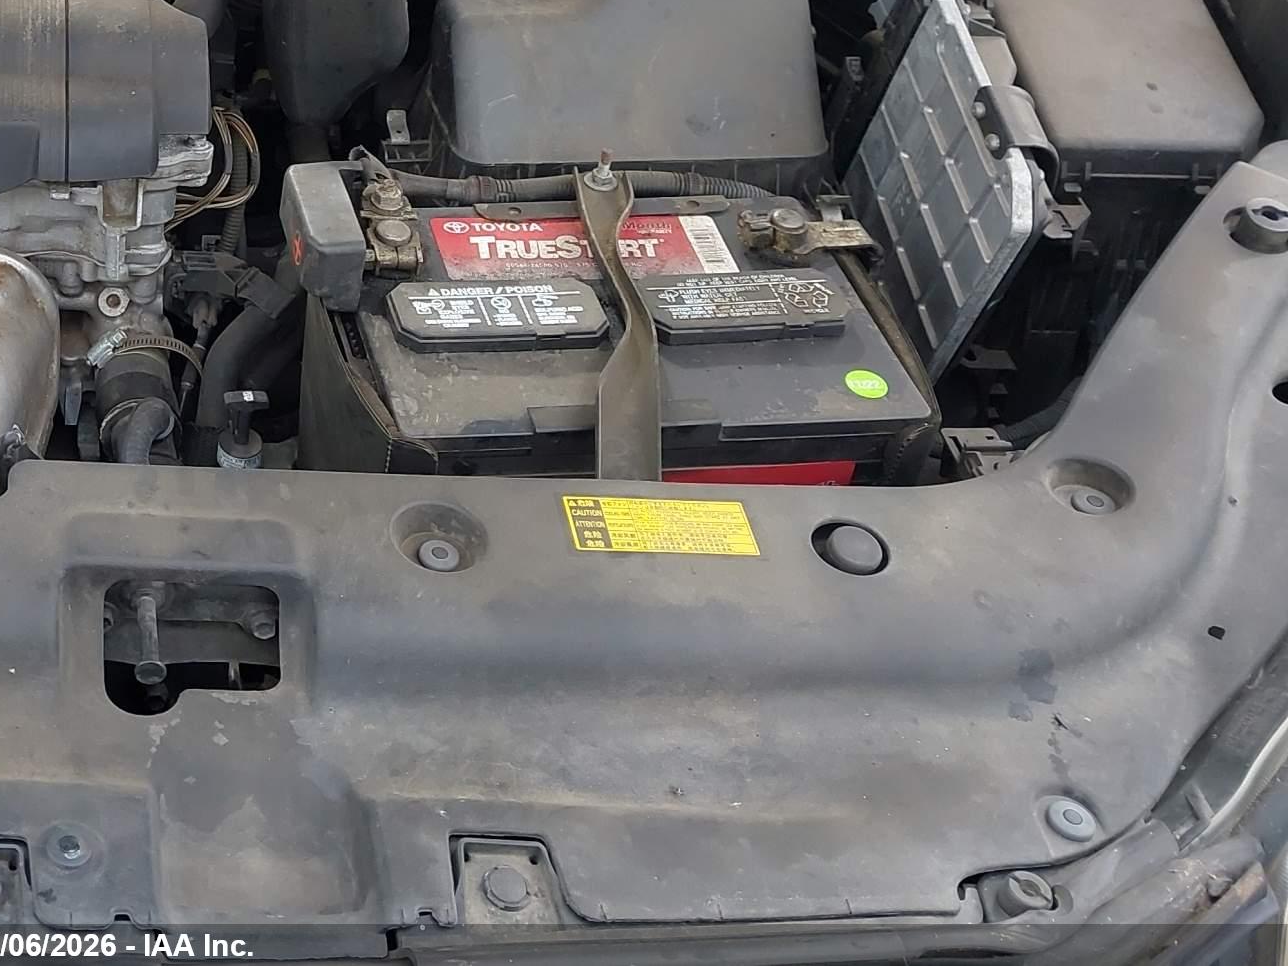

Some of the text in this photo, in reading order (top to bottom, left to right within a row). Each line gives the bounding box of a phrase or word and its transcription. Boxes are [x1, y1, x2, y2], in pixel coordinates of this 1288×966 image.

[470, 222, 544, 232] TOYOTA
[439, 287, 494, 296] DANGER
[506, 284, 554, 294] POISON
[571, 508, 603, 516] CAUTION
